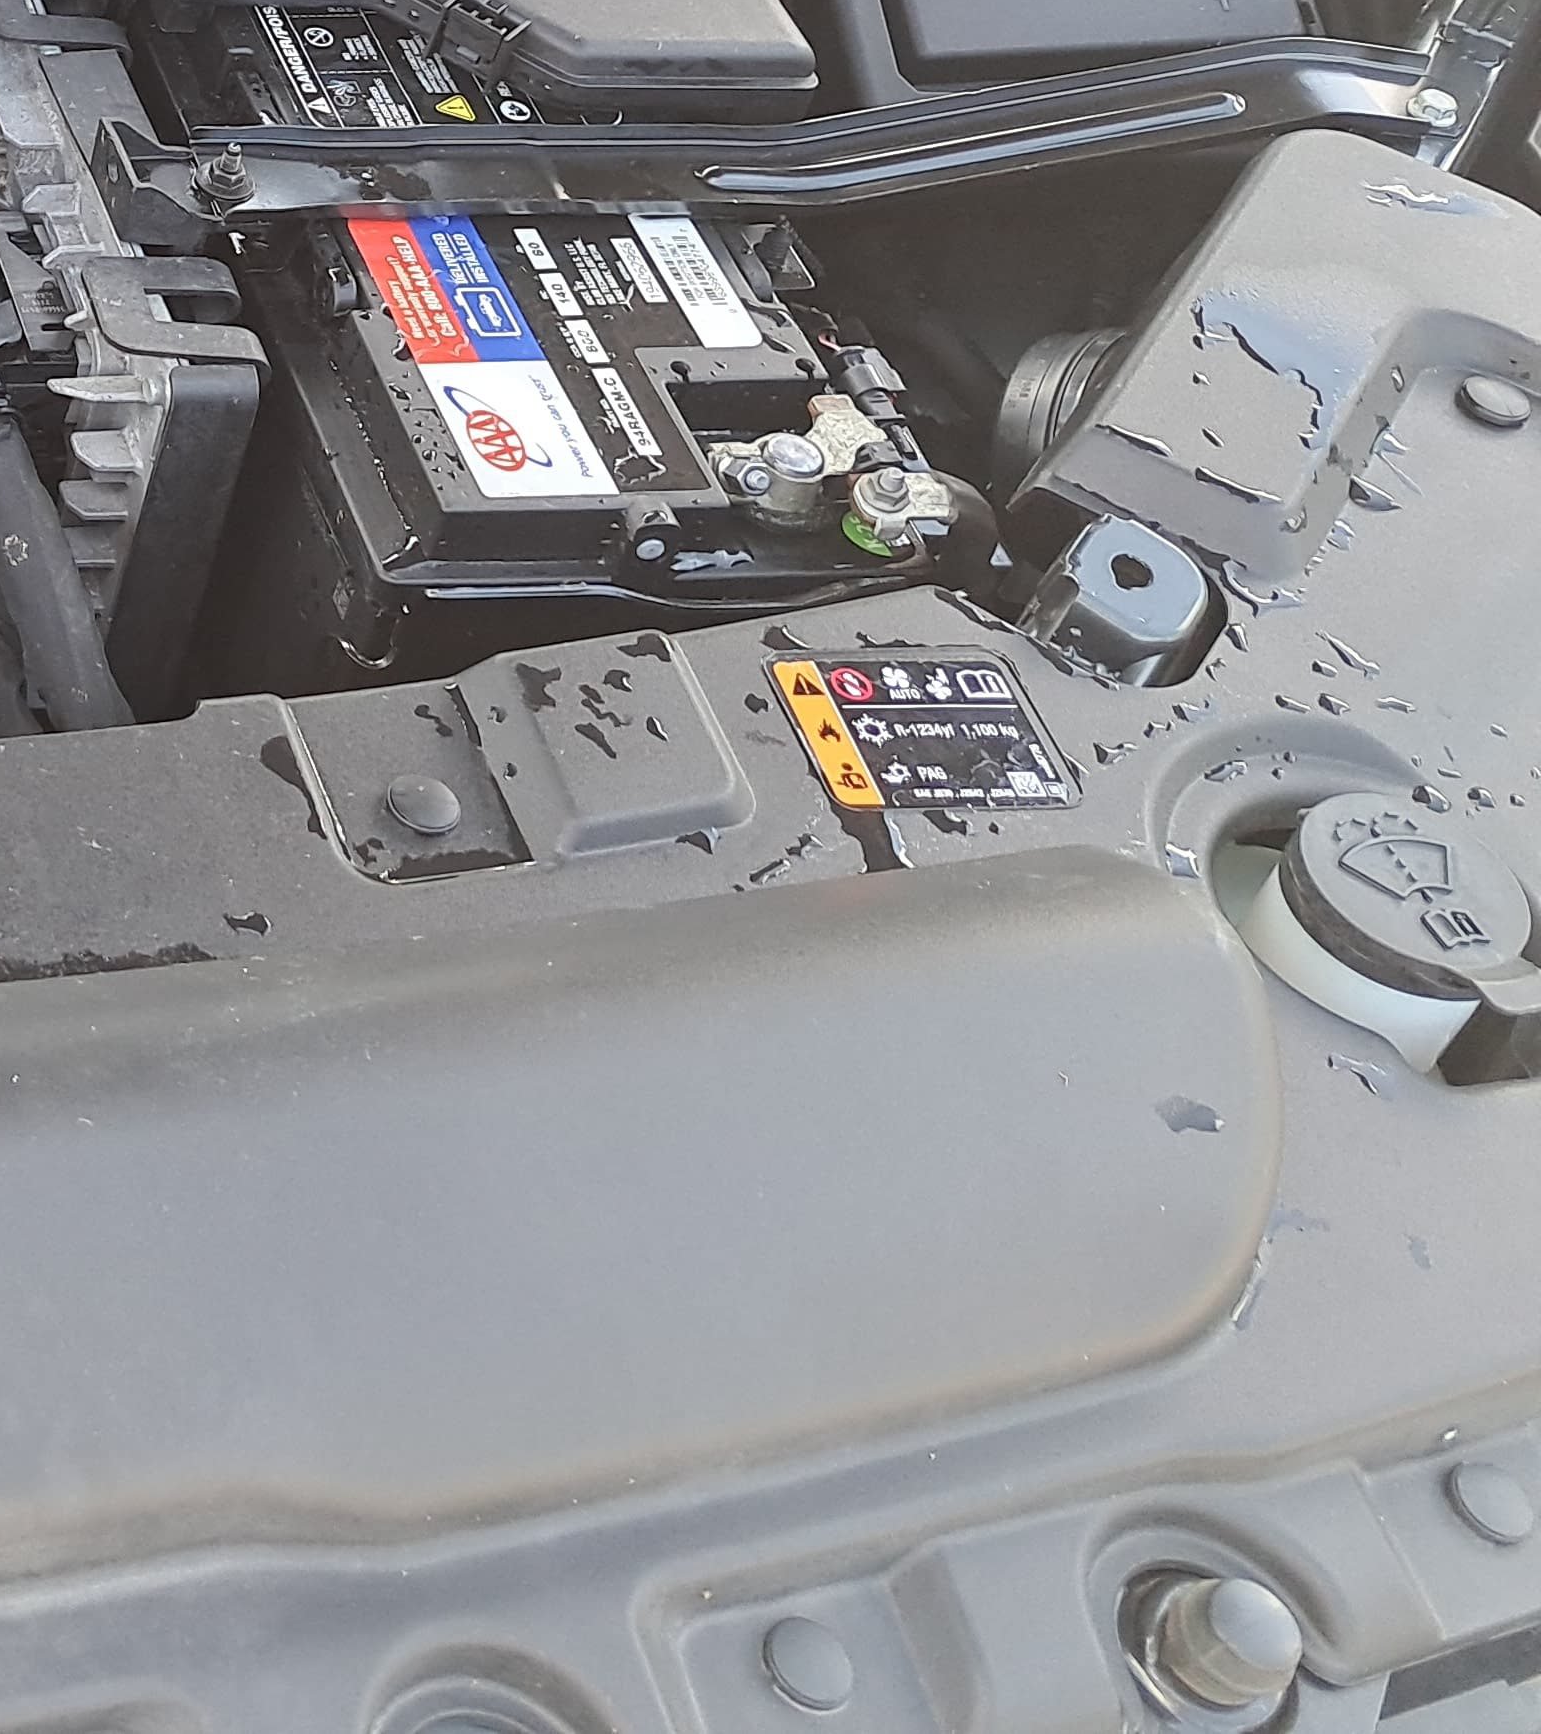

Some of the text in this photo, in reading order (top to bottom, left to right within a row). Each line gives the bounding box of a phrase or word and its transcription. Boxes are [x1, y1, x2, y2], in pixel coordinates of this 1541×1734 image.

[263, 6, 317, 93] DANGER/POIS
[429, 233, 468, 283] DELIVERED
[451, 233, 489, 282] INSTALLED
[550, 283, 571, 302] 140
[430, 312, 457, 336] Call:
[575, 330, 598, 352] 800
[544, 404, 562, 420] can
[602, 377, 651, 446] 94RAGM-C
[468, 414, 525, 469] AAA
[556, 423, 577, 442] you
[567, 445, 594, 477] Power
[889, 688, 921, 700] AUTO
[1000, 723, 1018, 740] kg
[917, 766, 948, 781] PAG
